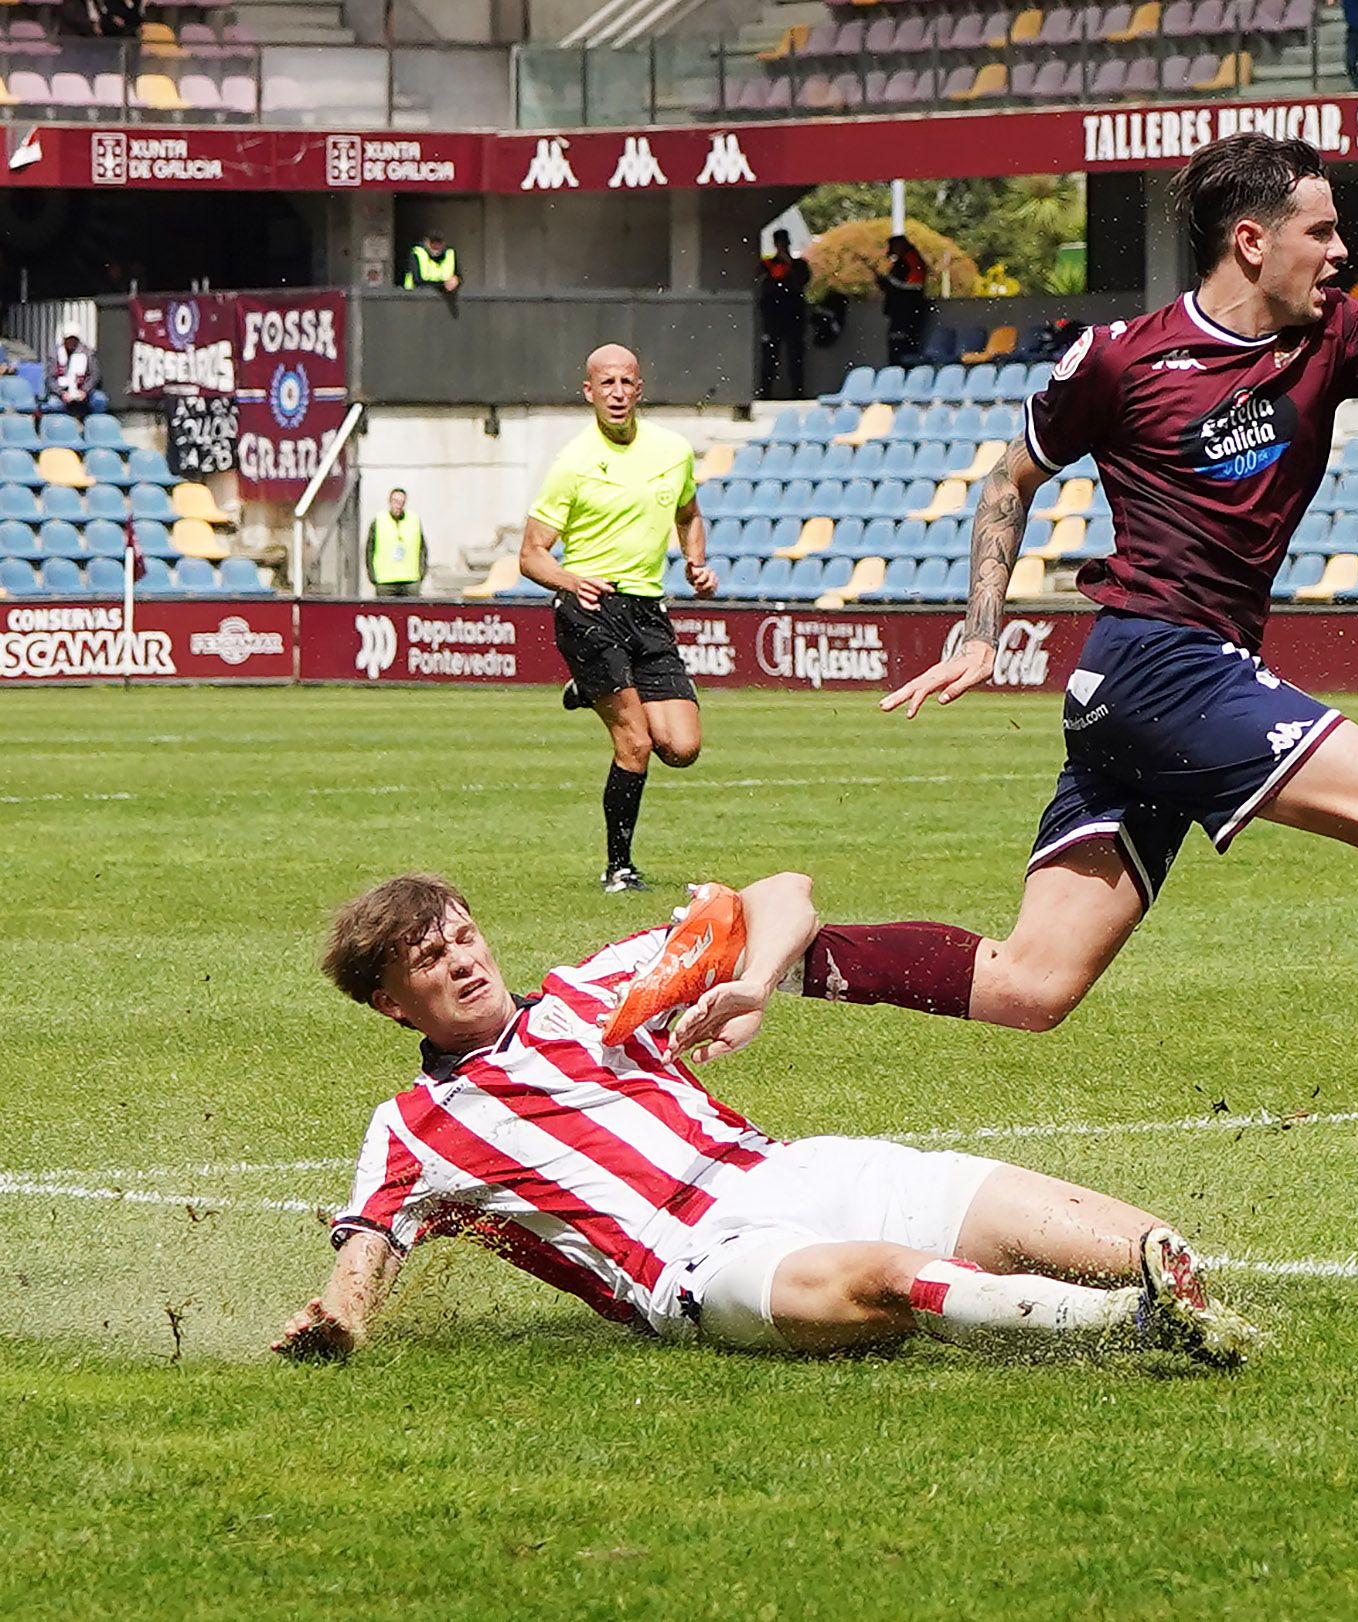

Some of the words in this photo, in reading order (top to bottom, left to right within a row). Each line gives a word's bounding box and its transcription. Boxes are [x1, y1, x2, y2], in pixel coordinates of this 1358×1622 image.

[1083, 109, 1212, 161] TALLERES
[130, 139, 187, 158] XUNTA
[363, 141, 420, 159] XUNTA
[129, 160, 152, 179] DE
[156, 160, 222, 179] GALICIA
[363, 161, 386, 180] DE
[388, 161, 454, 180] GALICIA
[242, 309, 338, 361] FOSSA
[1204, 420, 1276, 460] Galicia
[7, 608, 123, 631] CONSERVAS
[407, 615, 516, 650] Deputación
[408, 647, 516, 677] Pontevedra
